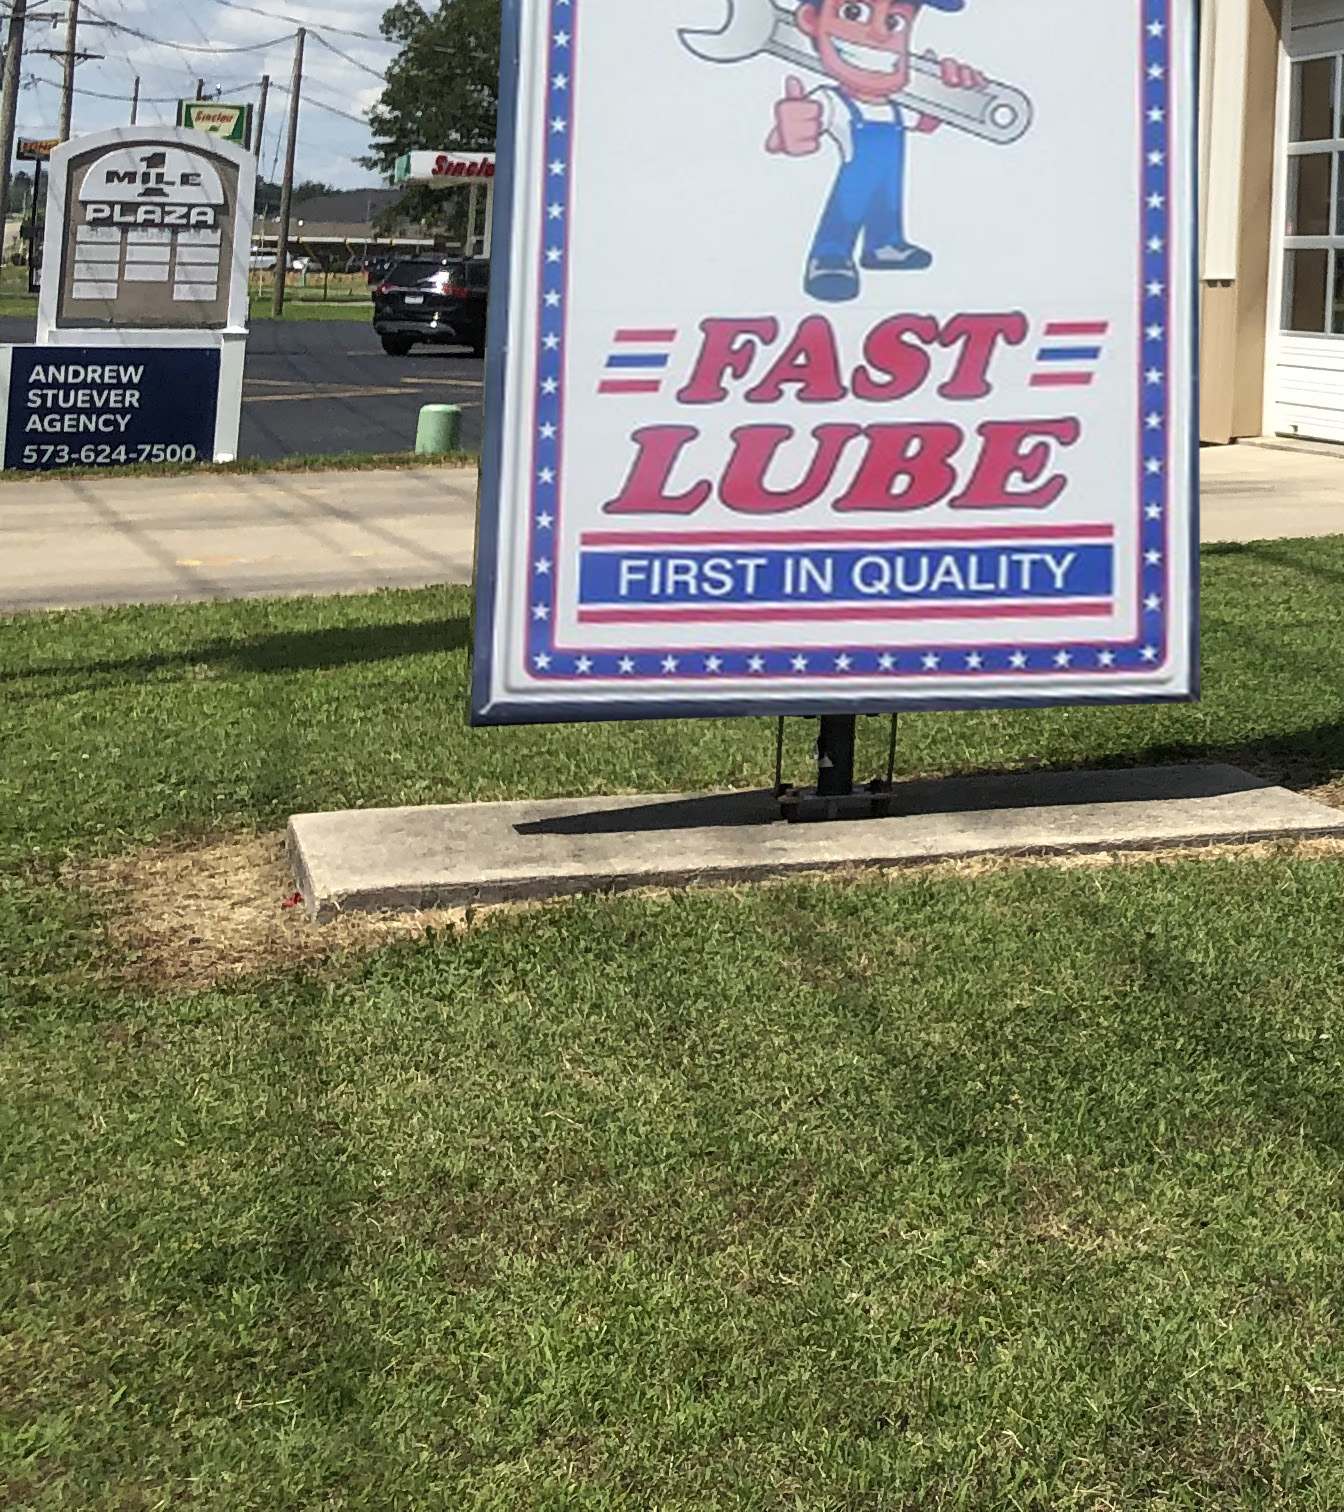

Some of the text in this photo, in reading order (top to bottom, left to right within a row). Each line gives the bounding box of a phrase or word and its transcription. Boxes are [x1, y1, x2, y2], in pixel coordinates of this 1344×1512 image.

[105, 170, 202, 187] MILE
[86, 204, 215, 225] PLAZA
[676, 312, 1027, 405] FAST
[28, 364, 144, 384] ANDREW
[26, 389, 140, 408] STUEVER
[25, 414, 131, 432] AGENCY
[22, 444, 196, 464] 573-624-7500
[602, 417, 1080, 516] LUBE
[619, 551, 1077, 596] FIRST IN QUALITY
